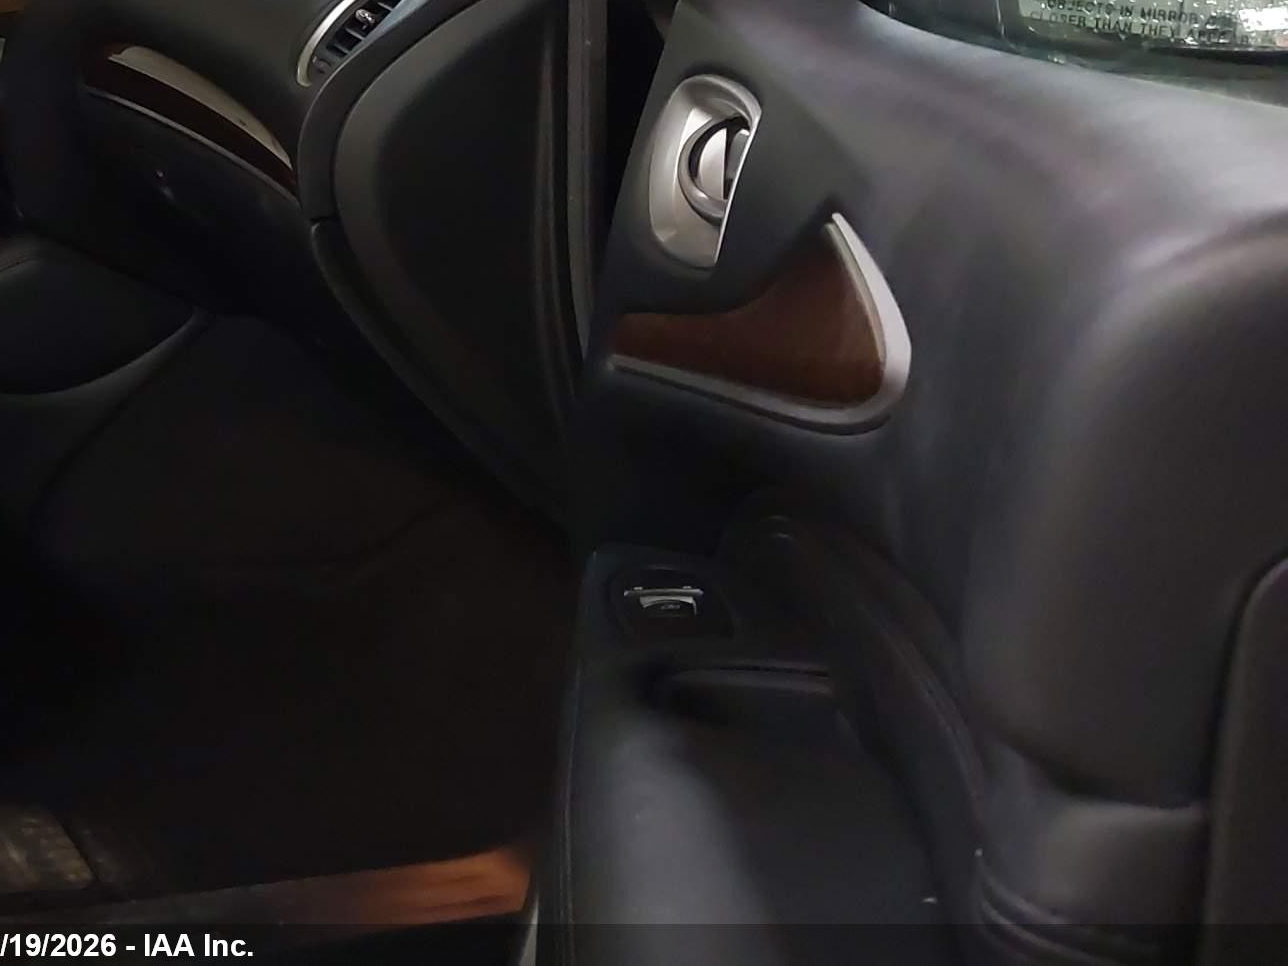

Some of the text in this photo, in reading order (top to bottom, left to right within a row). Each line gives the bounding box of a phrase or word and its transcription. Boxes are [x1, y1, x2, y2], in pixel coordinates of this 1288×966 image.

[1030, 10, 1086, 27] CLOSER
[1094, 17, 1133, 33] THAN
[1141, 22, 1178, 38] THEY
[1119, 5, 1133, 18] IN
[1141, 7, 1199, 24] MIRROR
